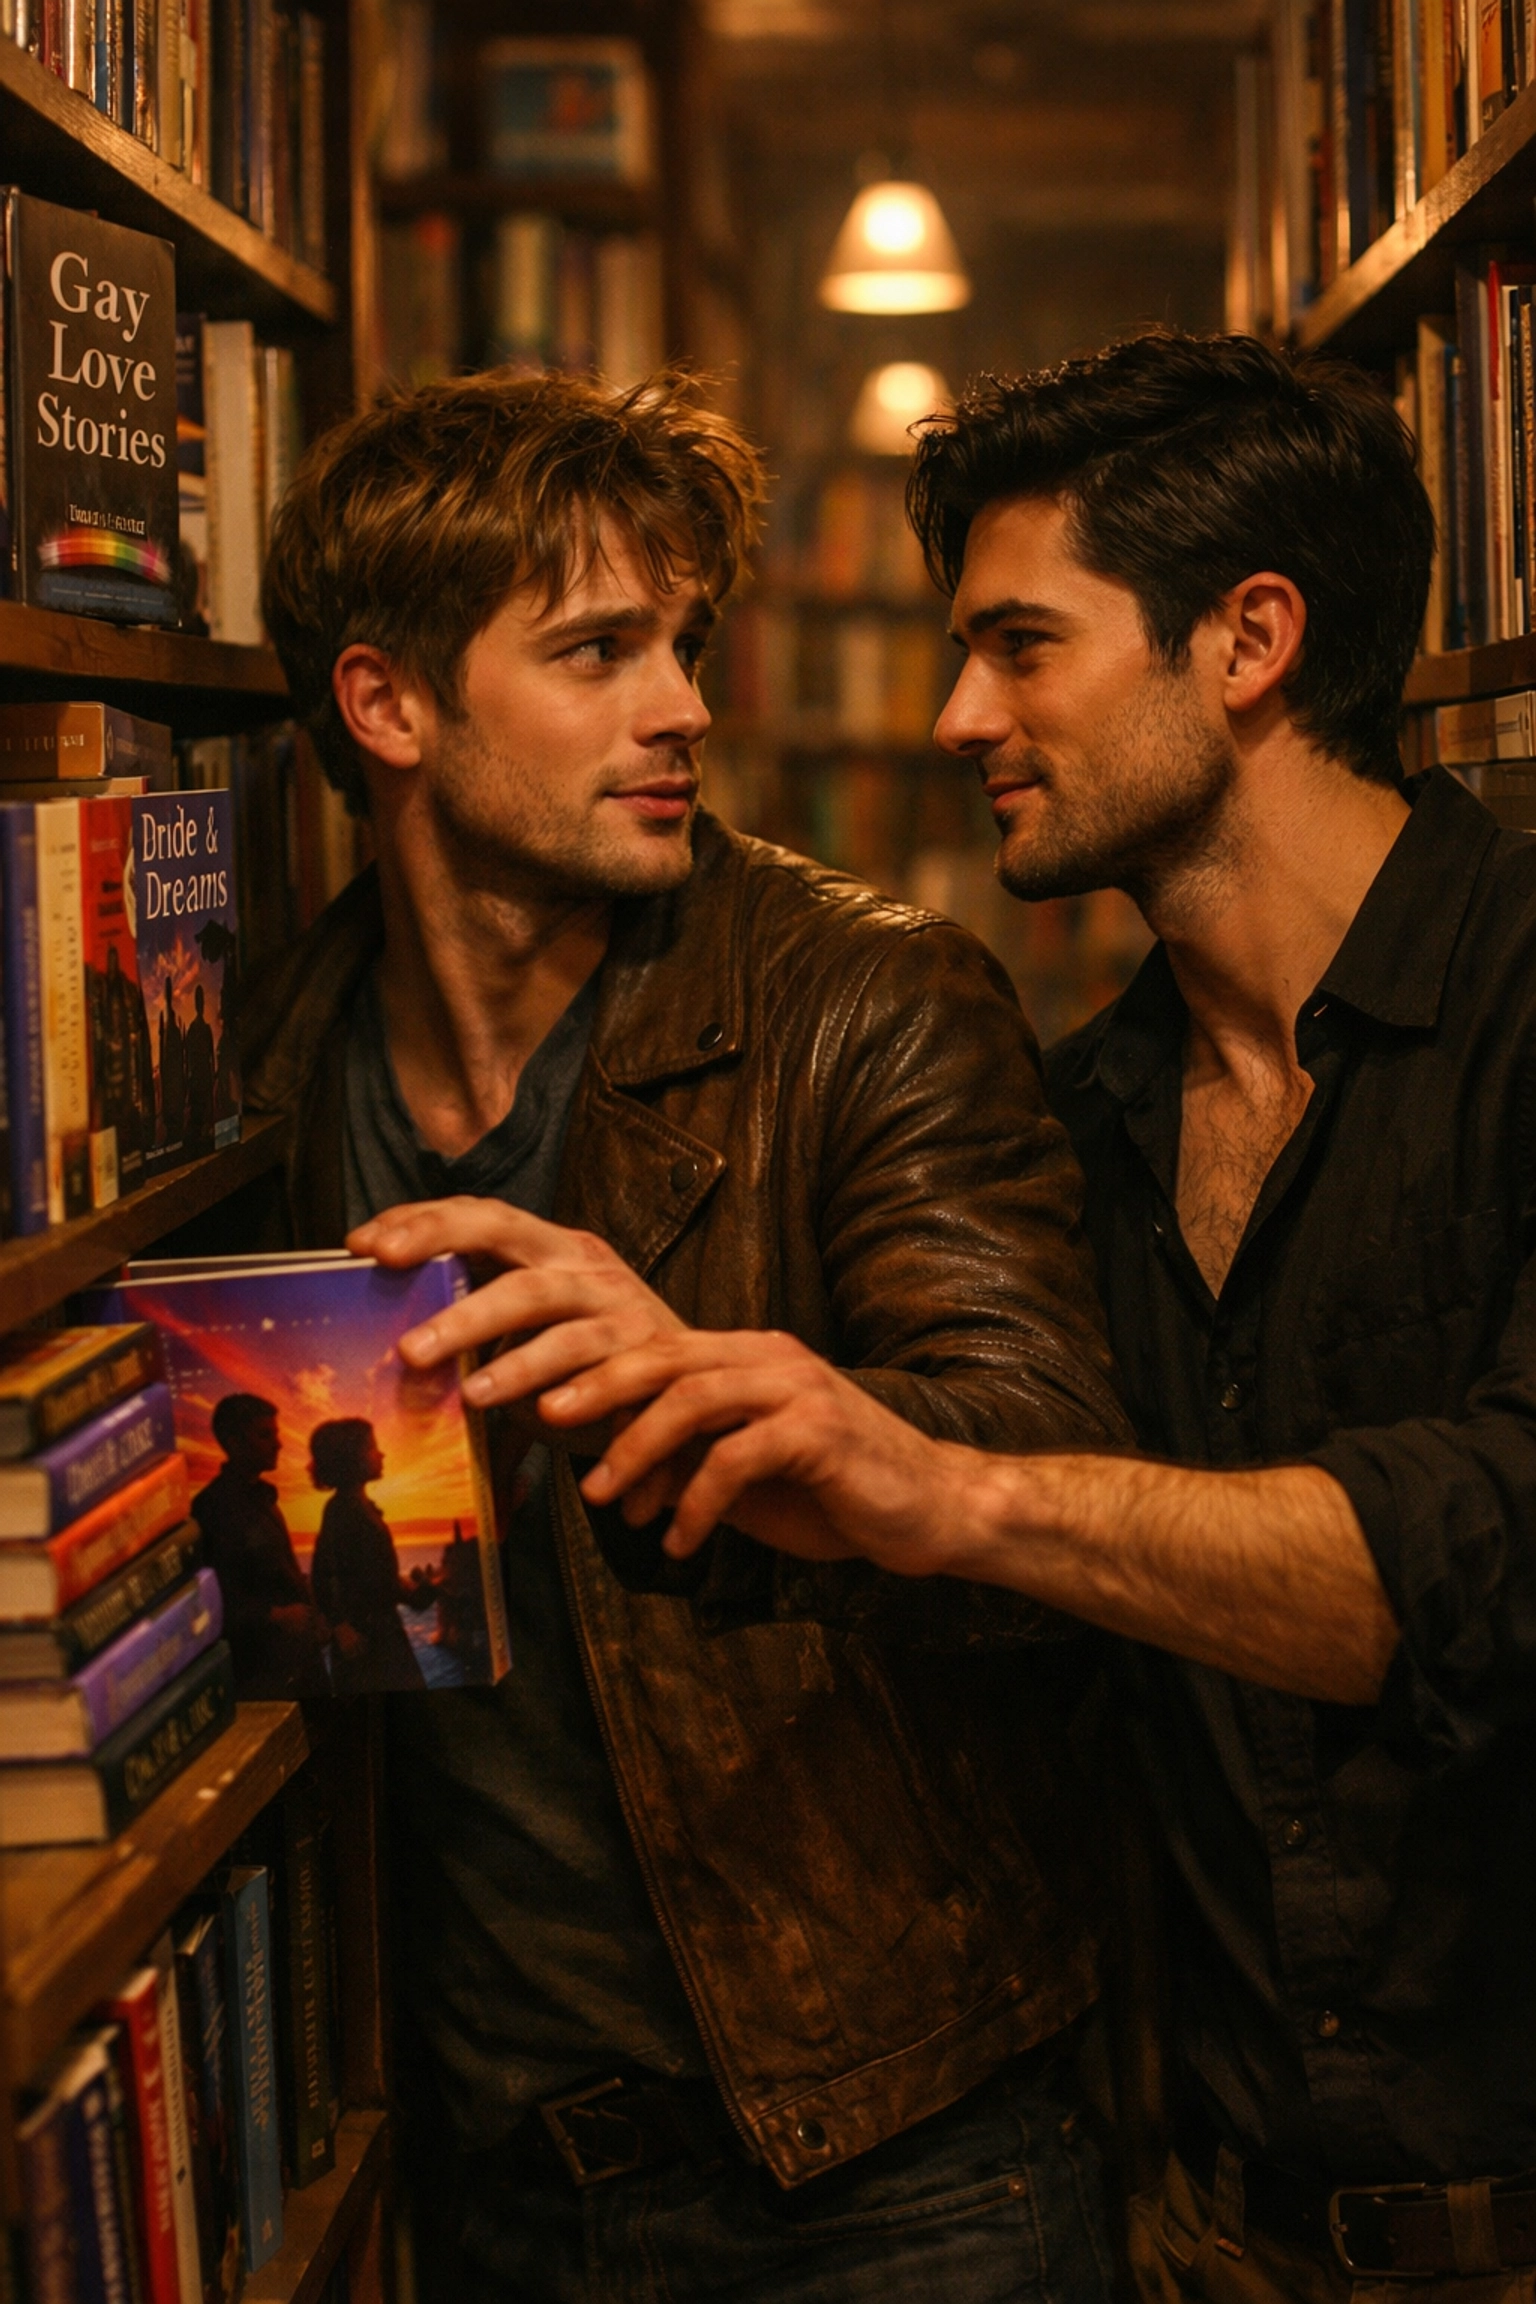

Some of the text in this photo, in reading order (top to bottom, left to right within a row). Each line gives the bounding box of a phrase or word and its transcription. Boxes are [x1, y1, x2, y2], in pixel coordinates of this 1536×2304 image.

[50, 251, 150, 342] Gay
[48, 320, 156, 401] Love
[37, 391, 166, 468] Stories
[206, 806, 218, 853] &
[146, 870, 228, 919] Dreams
